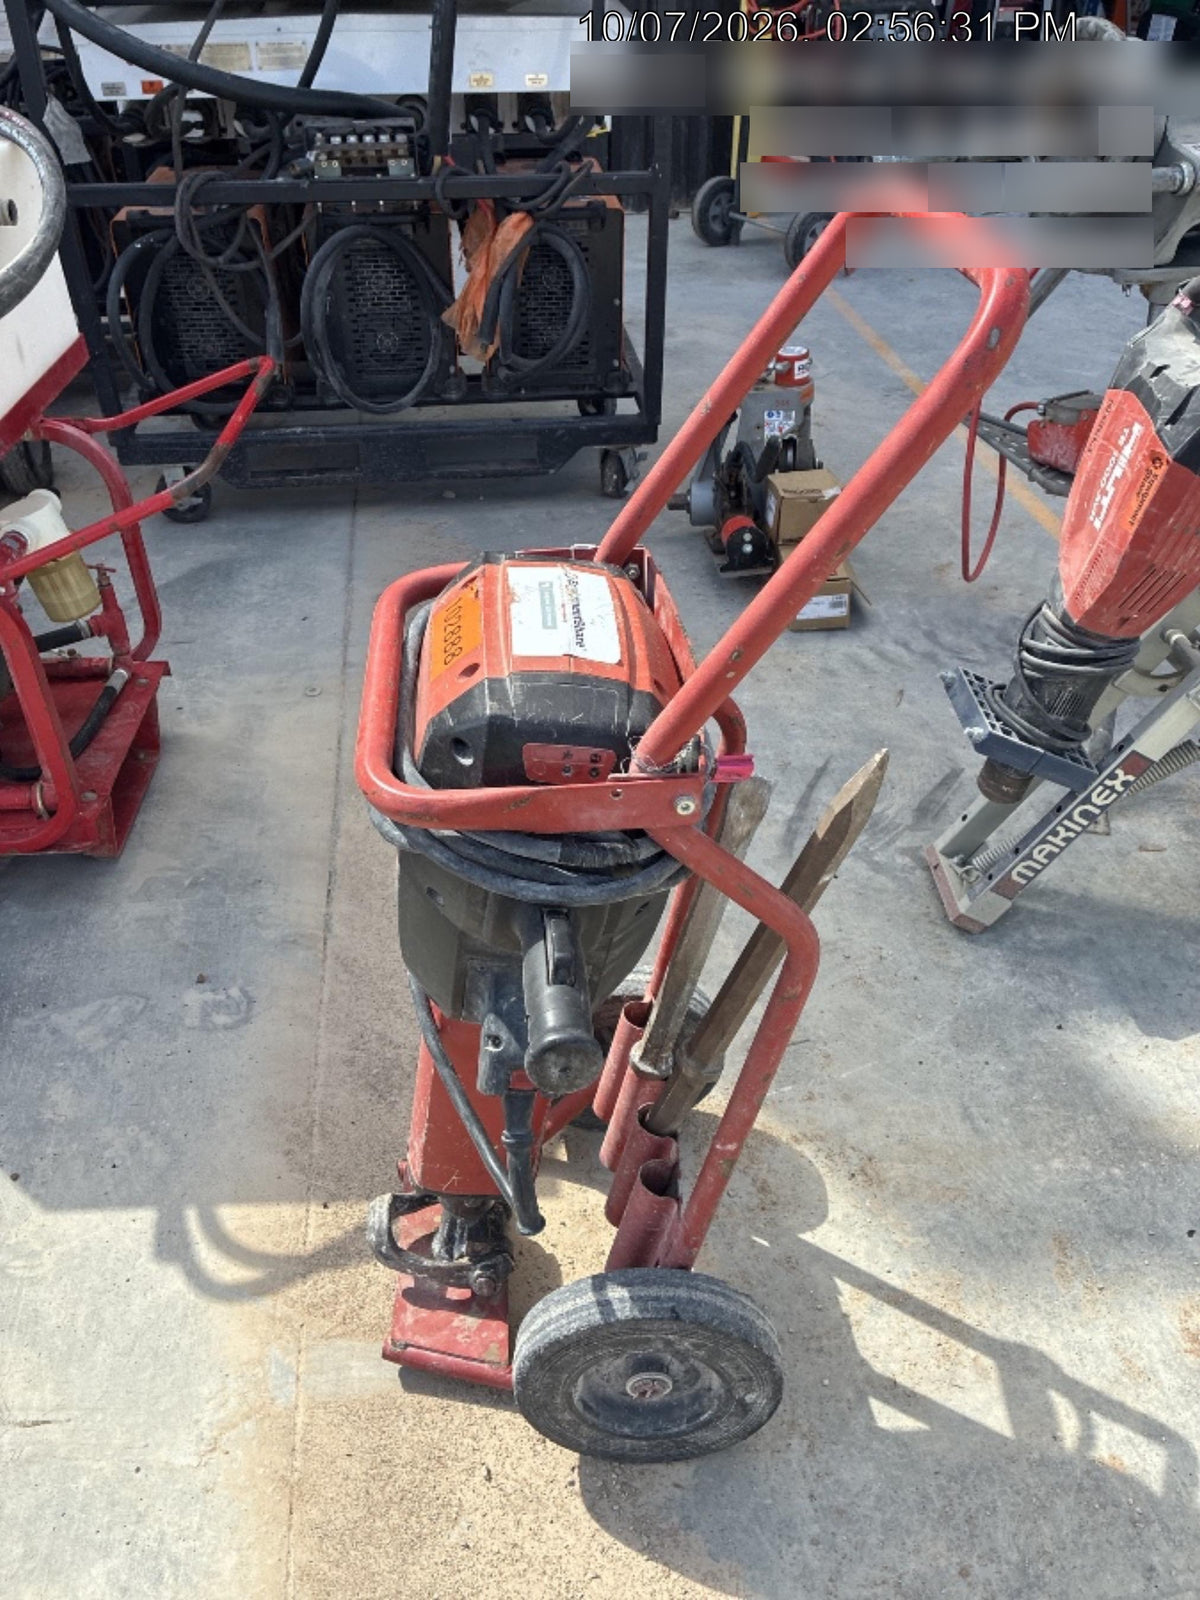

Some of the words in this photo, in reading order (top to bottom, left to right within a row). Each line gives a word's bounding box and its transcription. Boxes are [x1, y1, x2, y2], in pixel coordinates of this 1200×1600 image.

[1093, 422, 1144, 531] HILTI
[443, 597, 463, 667] 102888
[1011, 768, 1136, 885] MAKINEX
